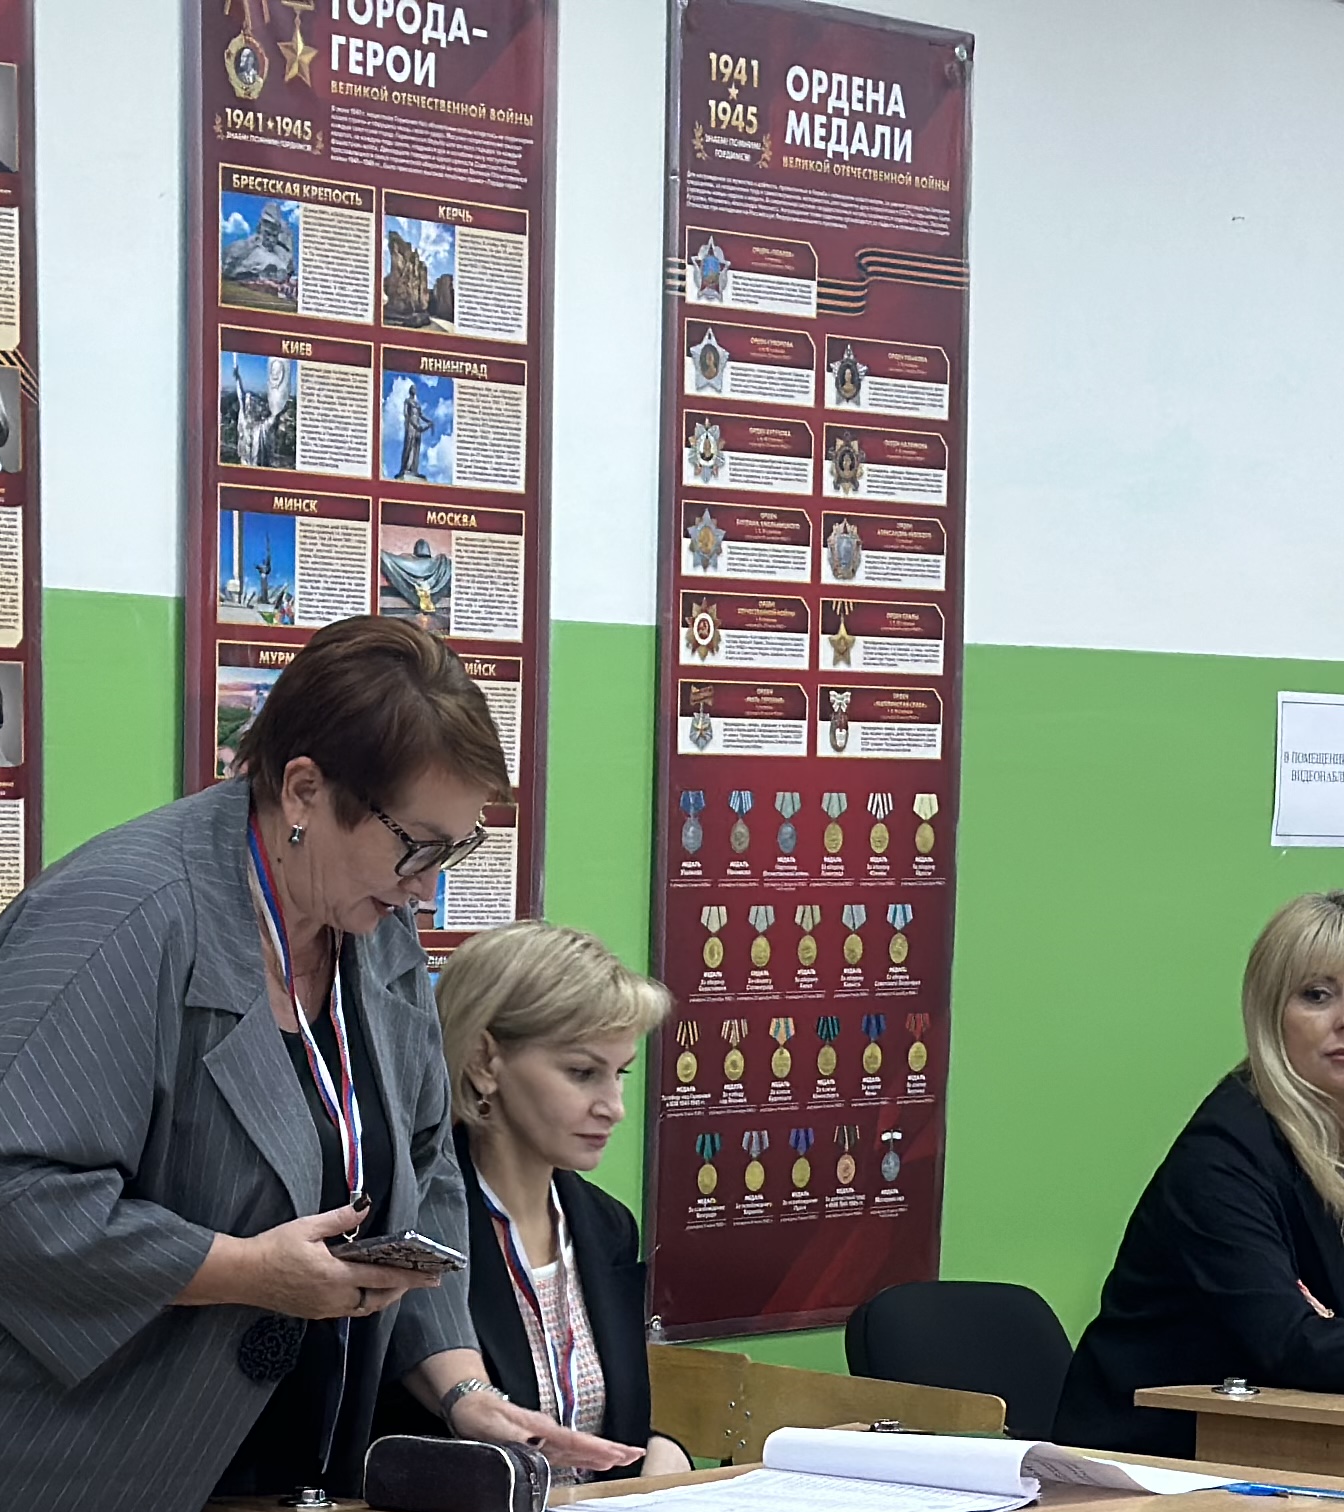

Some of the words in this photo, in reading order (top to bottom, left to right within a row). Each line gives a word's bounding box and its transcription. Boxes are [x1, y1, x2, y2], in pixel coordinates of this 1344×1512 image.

[331, 34, 436, 88] ГЕРОИ
[709, 52, 759, 88] 1941
[330, 80, 389, 102] ВЕЛИКОЙ
[392, 91, 487, 120] ОТЕЧЕСТВЕННОЙ
[489, 103, 534, 127] ВОЙНЫ
[785, 65, 906, 119] ОРДЕНА
[225, 107, 264, 132] 1941
[275, 115, 312, 141] 1945
[708, 99, 758, 134] 1945
[784, 110, 912, 163] МЕДАЛИ
[232, 174, 300, 197] БРЕСТСКАЯ
[302, 183, 363, 206] КРЕПОСТЬ
[782, 156, 831, 176] ВЕЛИКОЙ
[833, 163, 912, 186] ОТЕЧЕСТВЕННОЙ
[914, 174, 950, 192] ВОЙНЫ
[438, 205, 473, 223] КЕРЧЬ
[281, 339, 313, 356] КИЕВ
[420, 357, 488, 380] ЛЕНИНГРАД
[273, 496, 318, 512] МИНСК
[426, 511, 477, 528] МОСКВА
[259, 650, 295, 664] МУРМ
[1284, 752, 1290, 763] В
